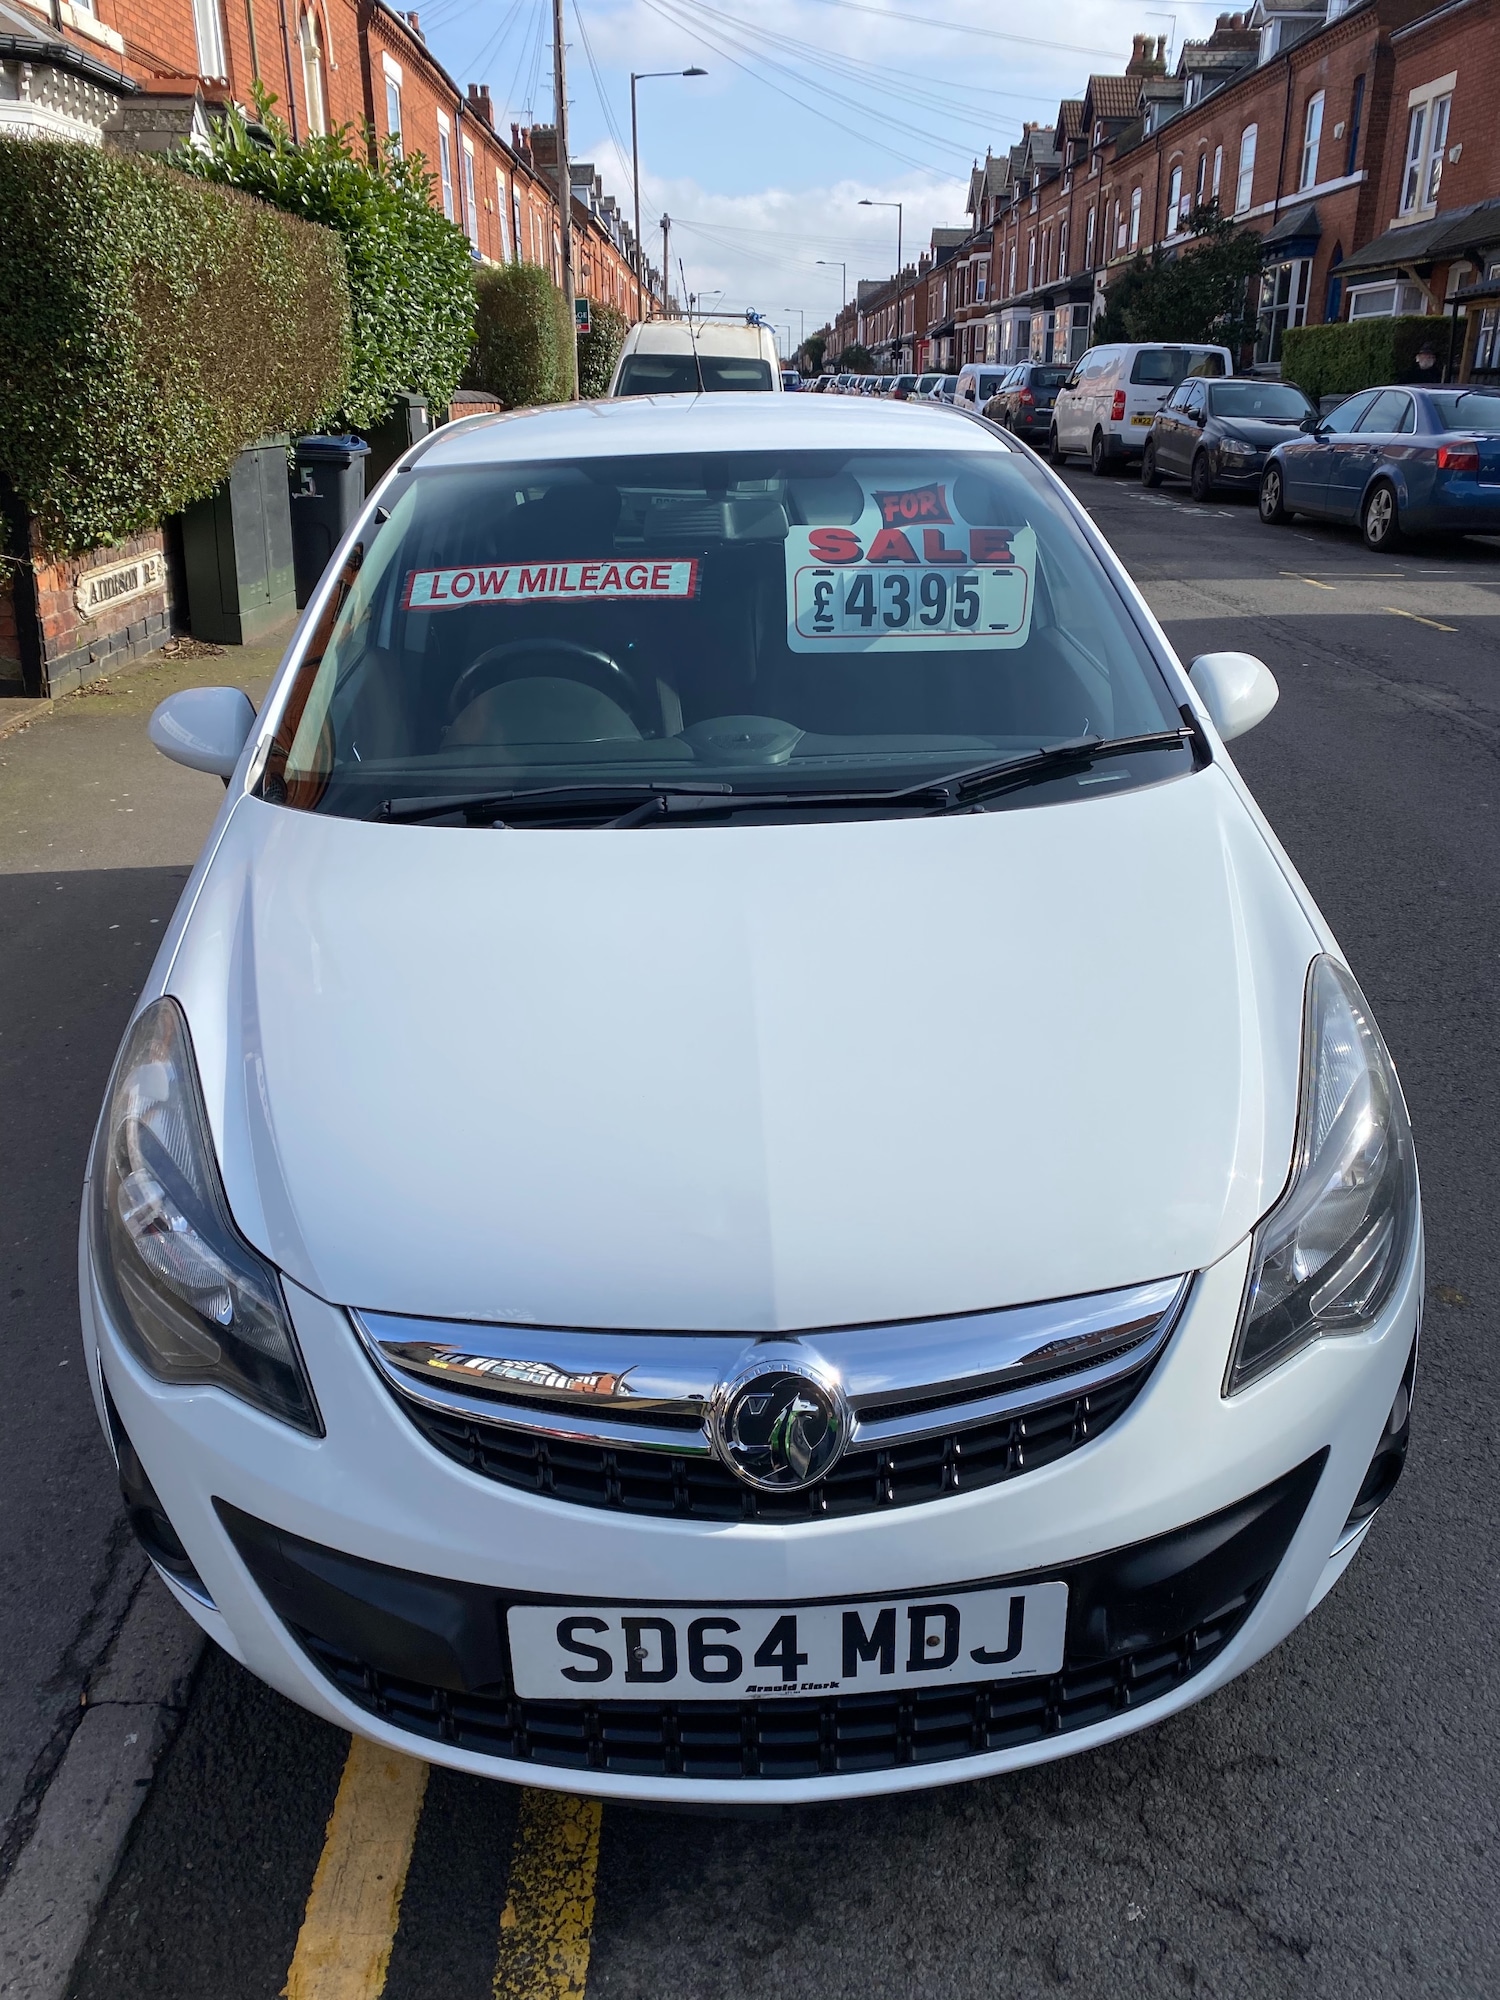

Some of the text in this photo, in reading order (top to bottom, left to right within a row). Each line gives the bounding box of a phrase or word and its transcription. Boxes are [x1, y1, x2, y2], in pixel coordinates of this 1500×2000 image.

[882, 490, 939, 523] FOR
[808, 527, 1015, 564] SALE
[87, 566, 139, 607] ADDISON
[429, 564, 673, 599] LOW MILEAGE
[813, 572, 980, 628] £4395
[555, 1595, 1026, 1684] SD64 MDJ
[745, 1681, 840, 1692] Arnold Clark
